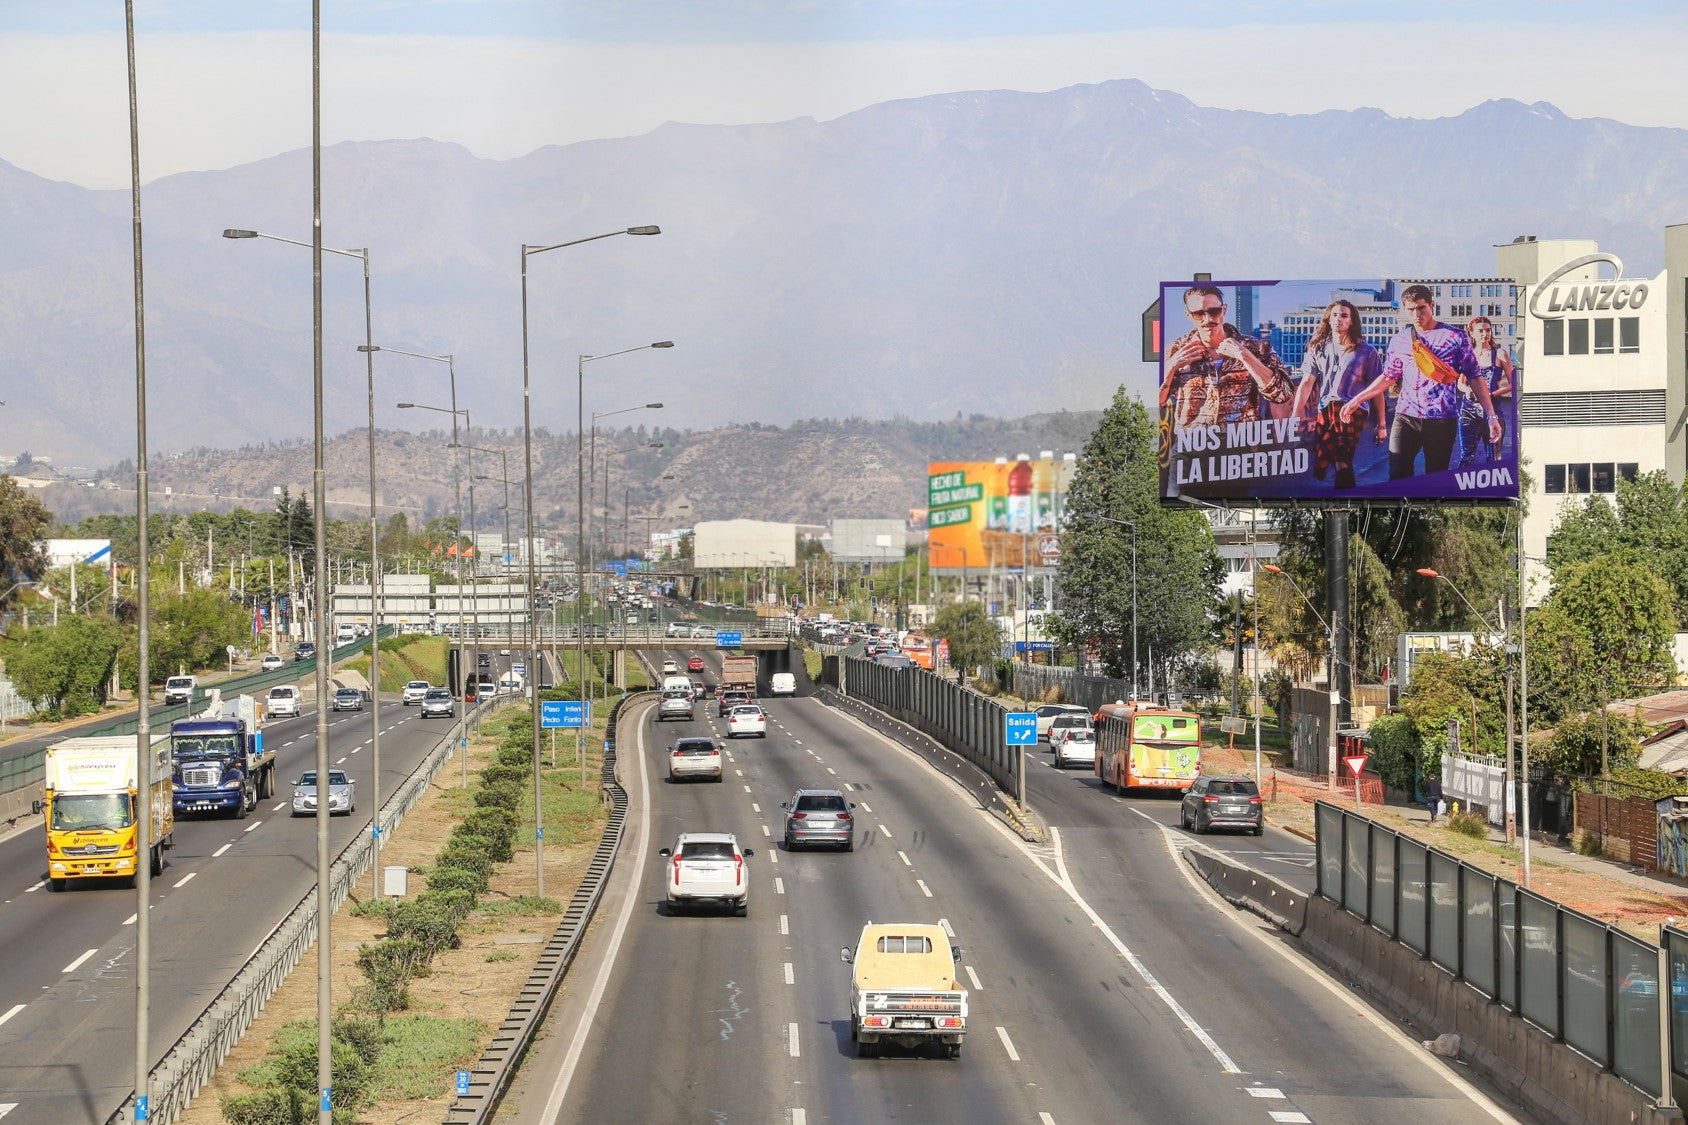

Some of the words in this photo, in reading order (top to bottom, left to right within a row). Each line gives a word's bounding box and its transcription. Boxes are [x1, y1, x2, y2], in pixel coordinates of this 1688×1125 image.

[1548, 284, 1649, 312] LANZCO
[1177, 424, 1220, 453] NOS
[1226, 417, 1300, 449] MUEVE
[1176, 457, 1203, 485] LA
[1208, 448, 1309, 482] LIBERTAD
[931, 475, 952, 490] HECHO
[1454, 467, 1513, 490] WOM
[931, 490, 950, 506] FRUTA
[951, 486, 979, 502] NATURAL
[931, 510, 946, 525] RICO
[946, 507, 968, 523] SABOR
[544, 705, 560, 713] Paso
[563, 715, 588, 723] Fonto
[1008, 718, 1036, 726] Salida
[1014, 731, 1020, 739] 5
